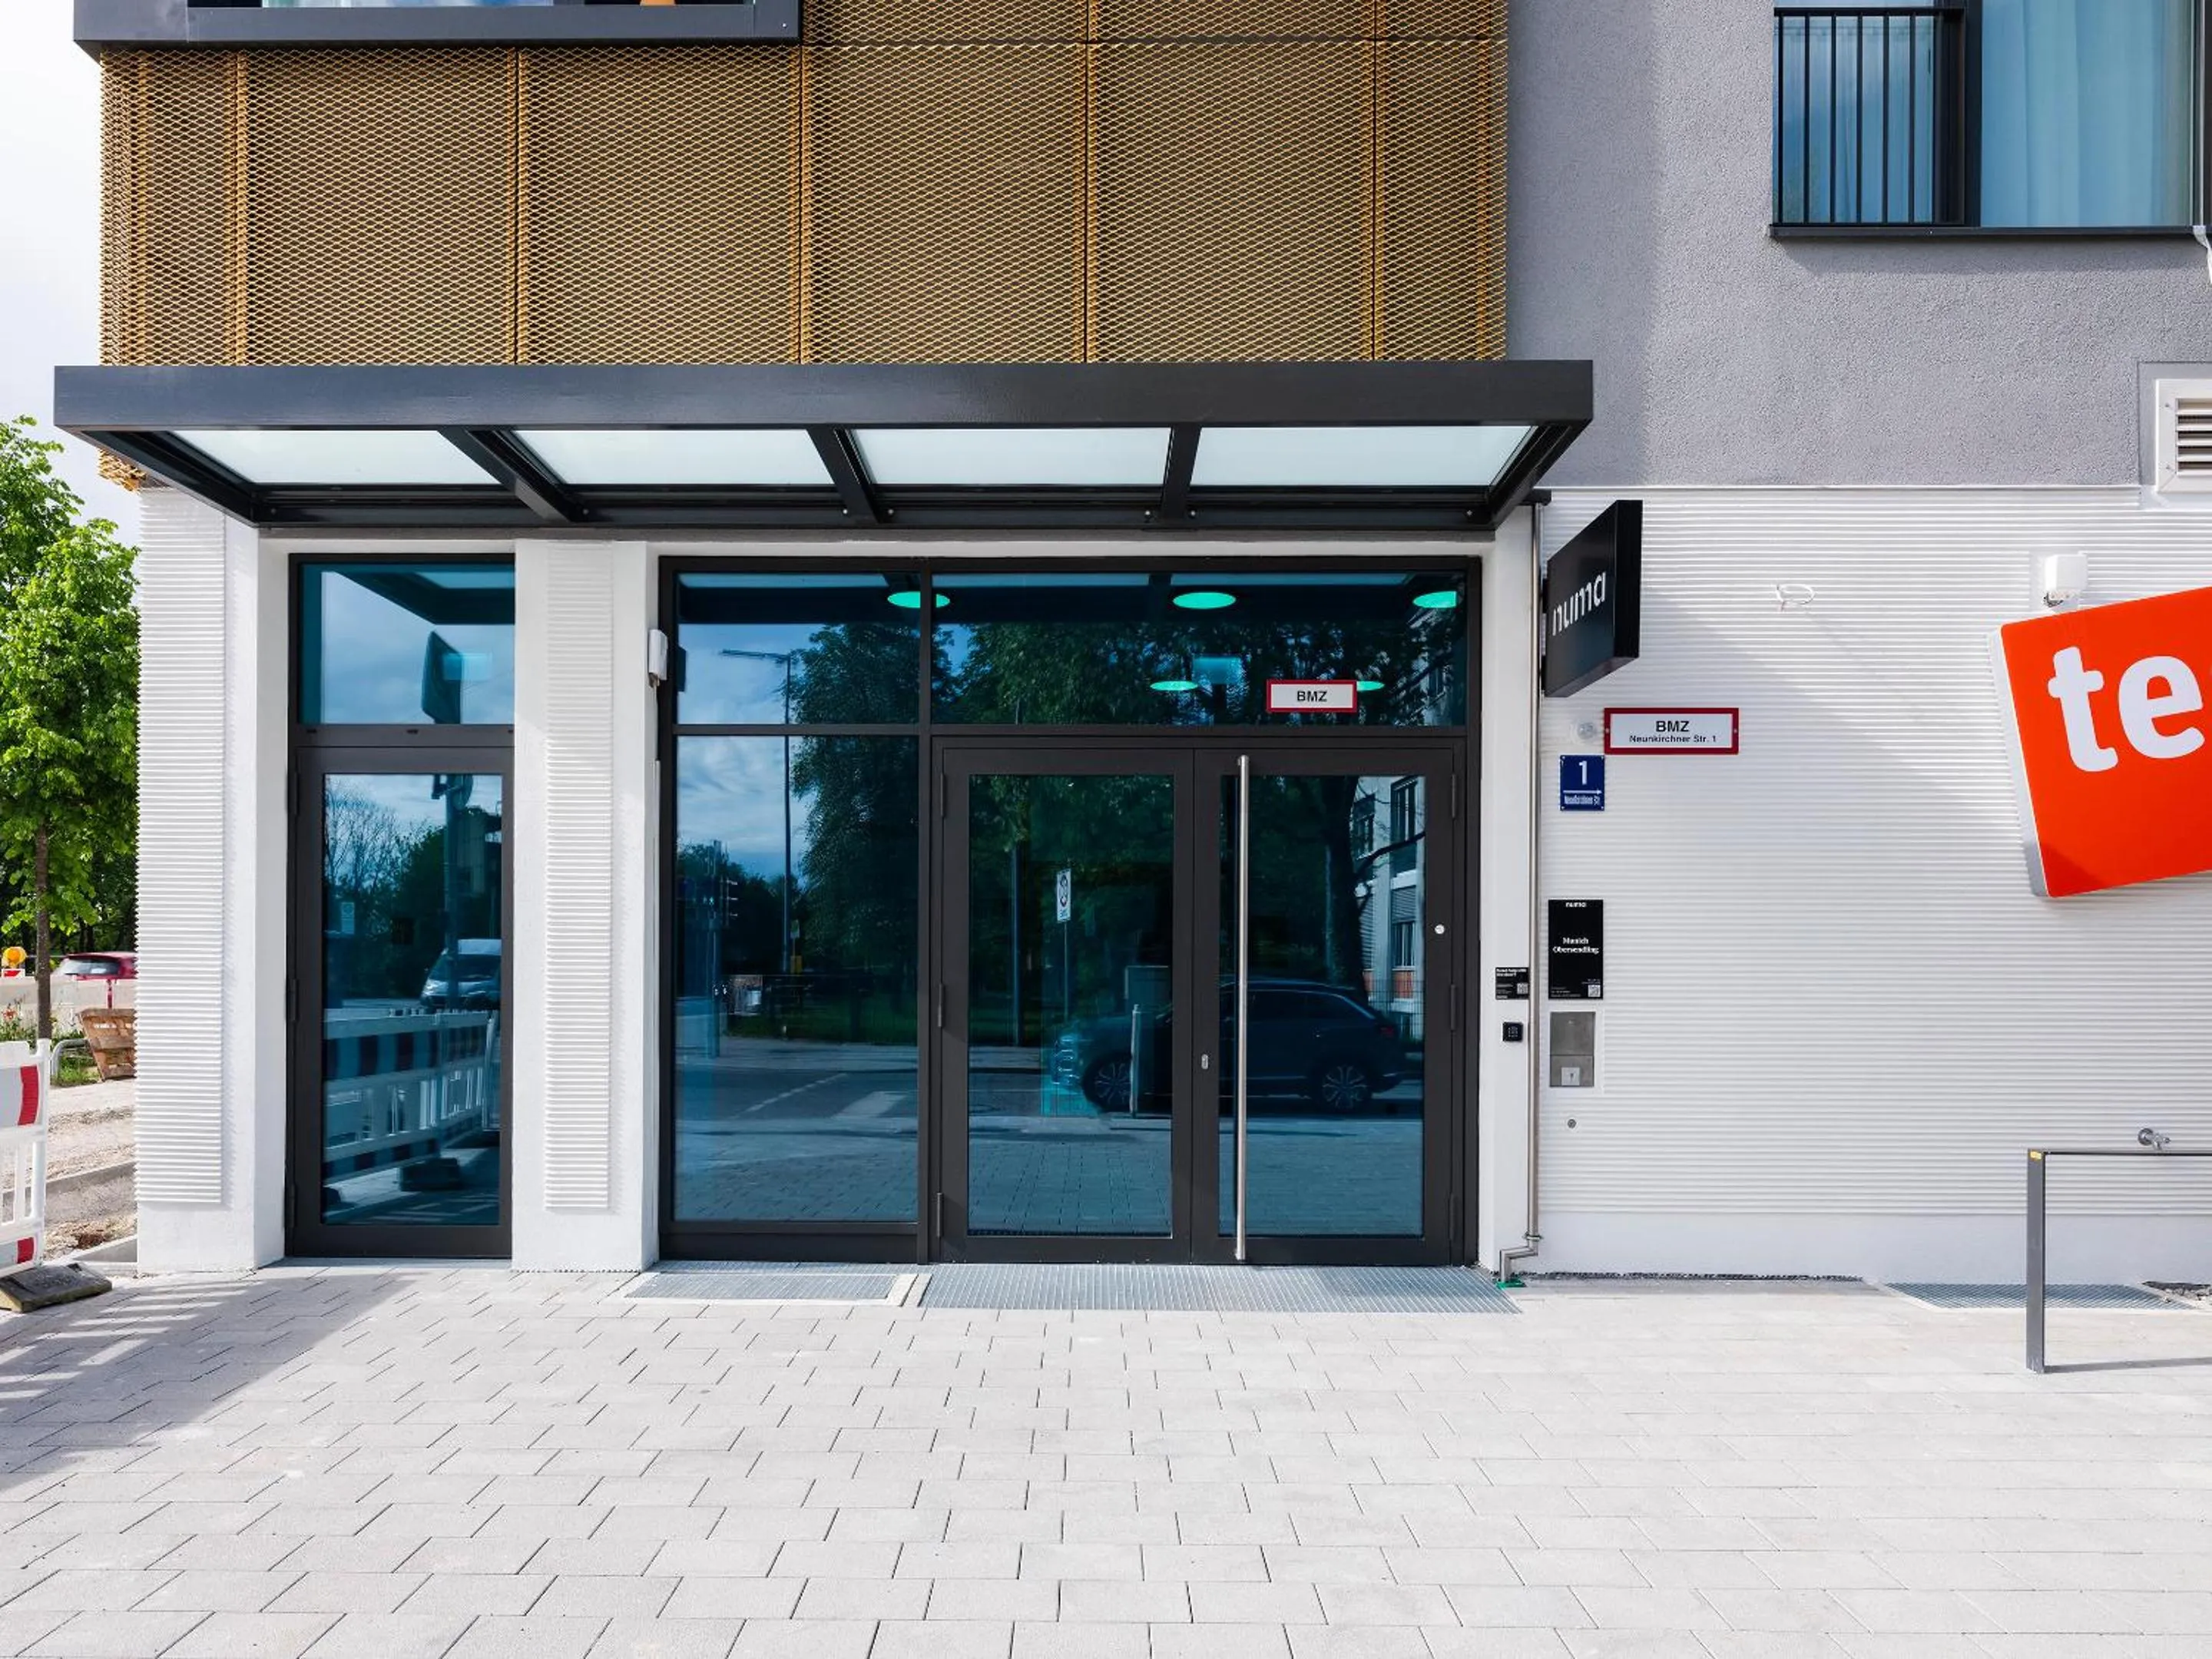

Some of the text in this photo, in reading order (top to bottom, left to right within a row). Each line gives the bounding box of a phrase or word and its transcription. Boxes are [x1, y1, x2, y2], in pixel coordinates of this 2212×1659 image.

[1551, 571, 1607, 637] numa
[1296, 690, 1327, 703] BMZ
[2048, 646, 2212, 772] te
[1655, 720, 1690, 733] BMZ
[1629, 734, 1690, 743] Neunkirchner
[1693, 734, 1709, 743] Str.
[1578, 760, 1588, 785] 1
